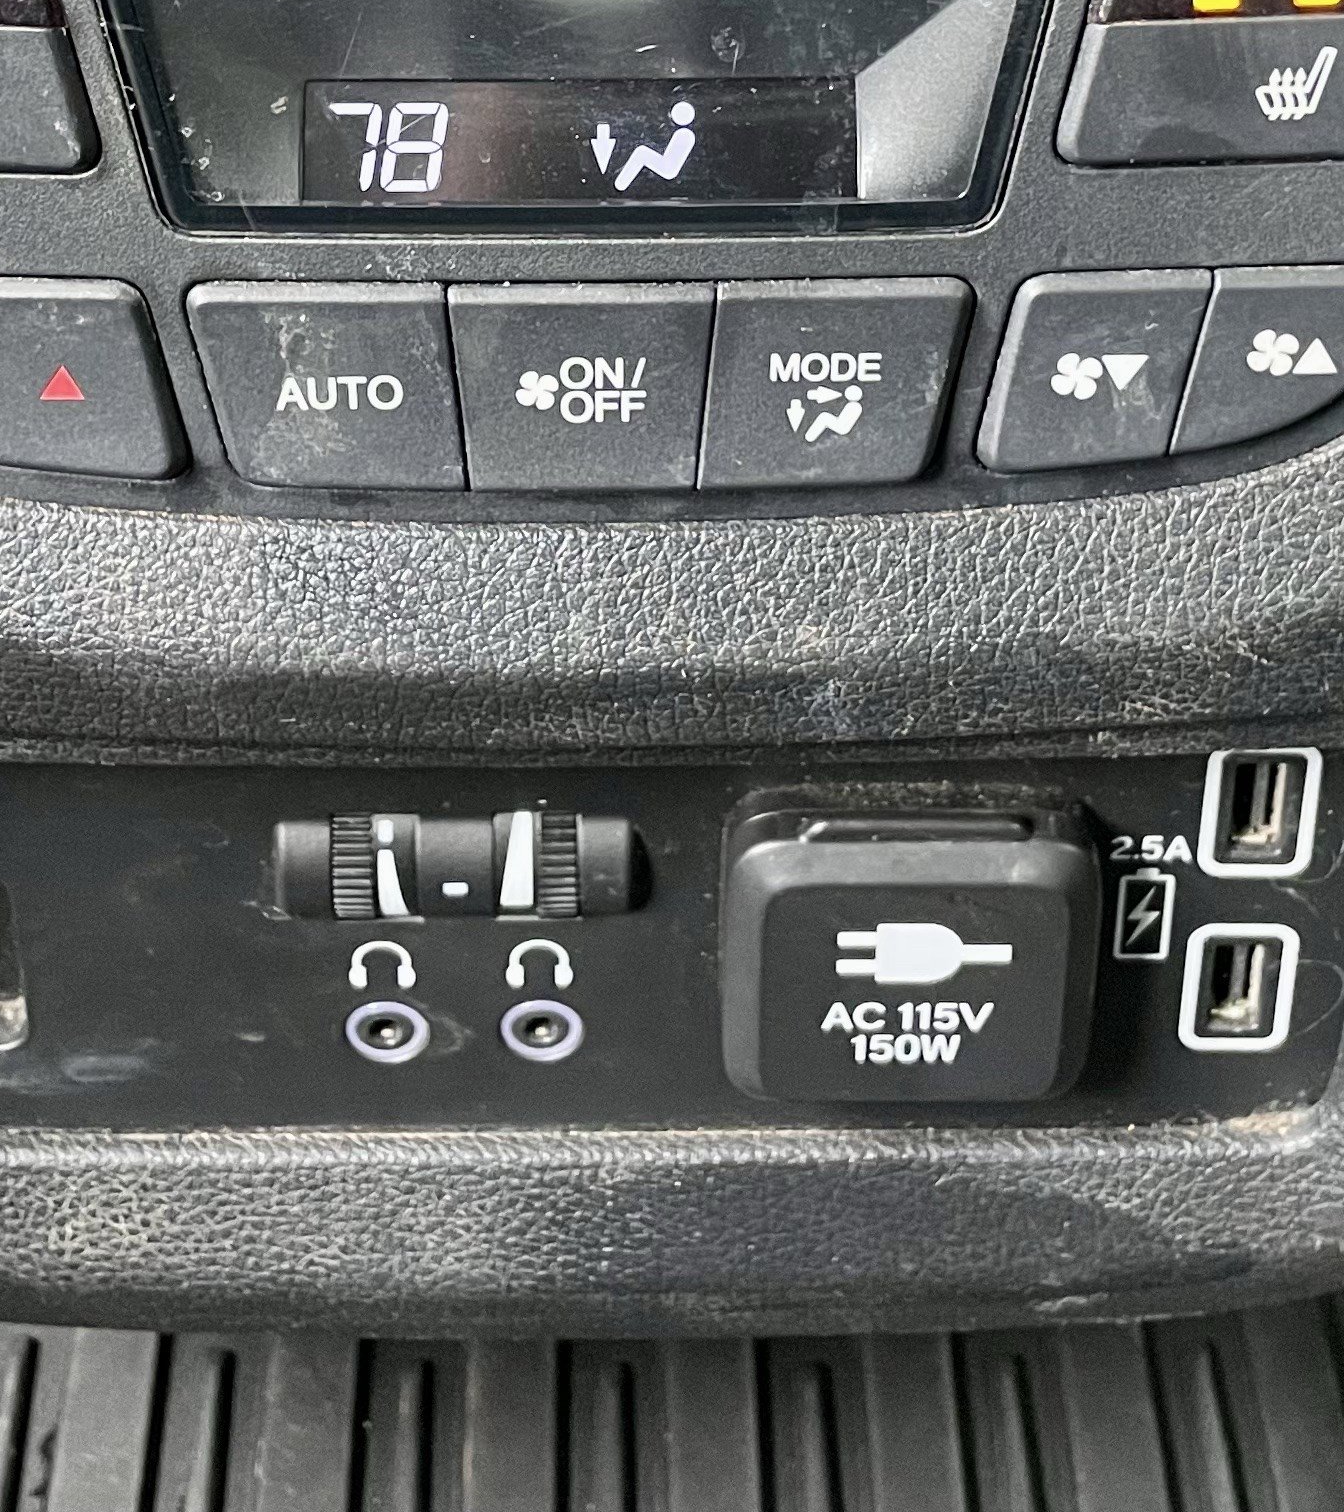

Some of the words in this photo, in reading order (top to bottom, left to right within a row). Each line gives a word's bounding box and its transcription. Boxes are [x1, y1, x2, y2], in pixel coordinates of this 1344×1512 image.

[329, 101, 449, 193] 78
[559, 356, 647, 390] ON/
[769, 352, 883, 383] MODE
[276, 375, 404, 412] AUTO
[559, 390, 647, 424] OFF
[1110, 834, 1193, 863] 2.5A
[819, 1001, 887, 1032] AC
[897, 1001, 995, 1033] 115V
[849, 1034, 962, 1064] 150W
